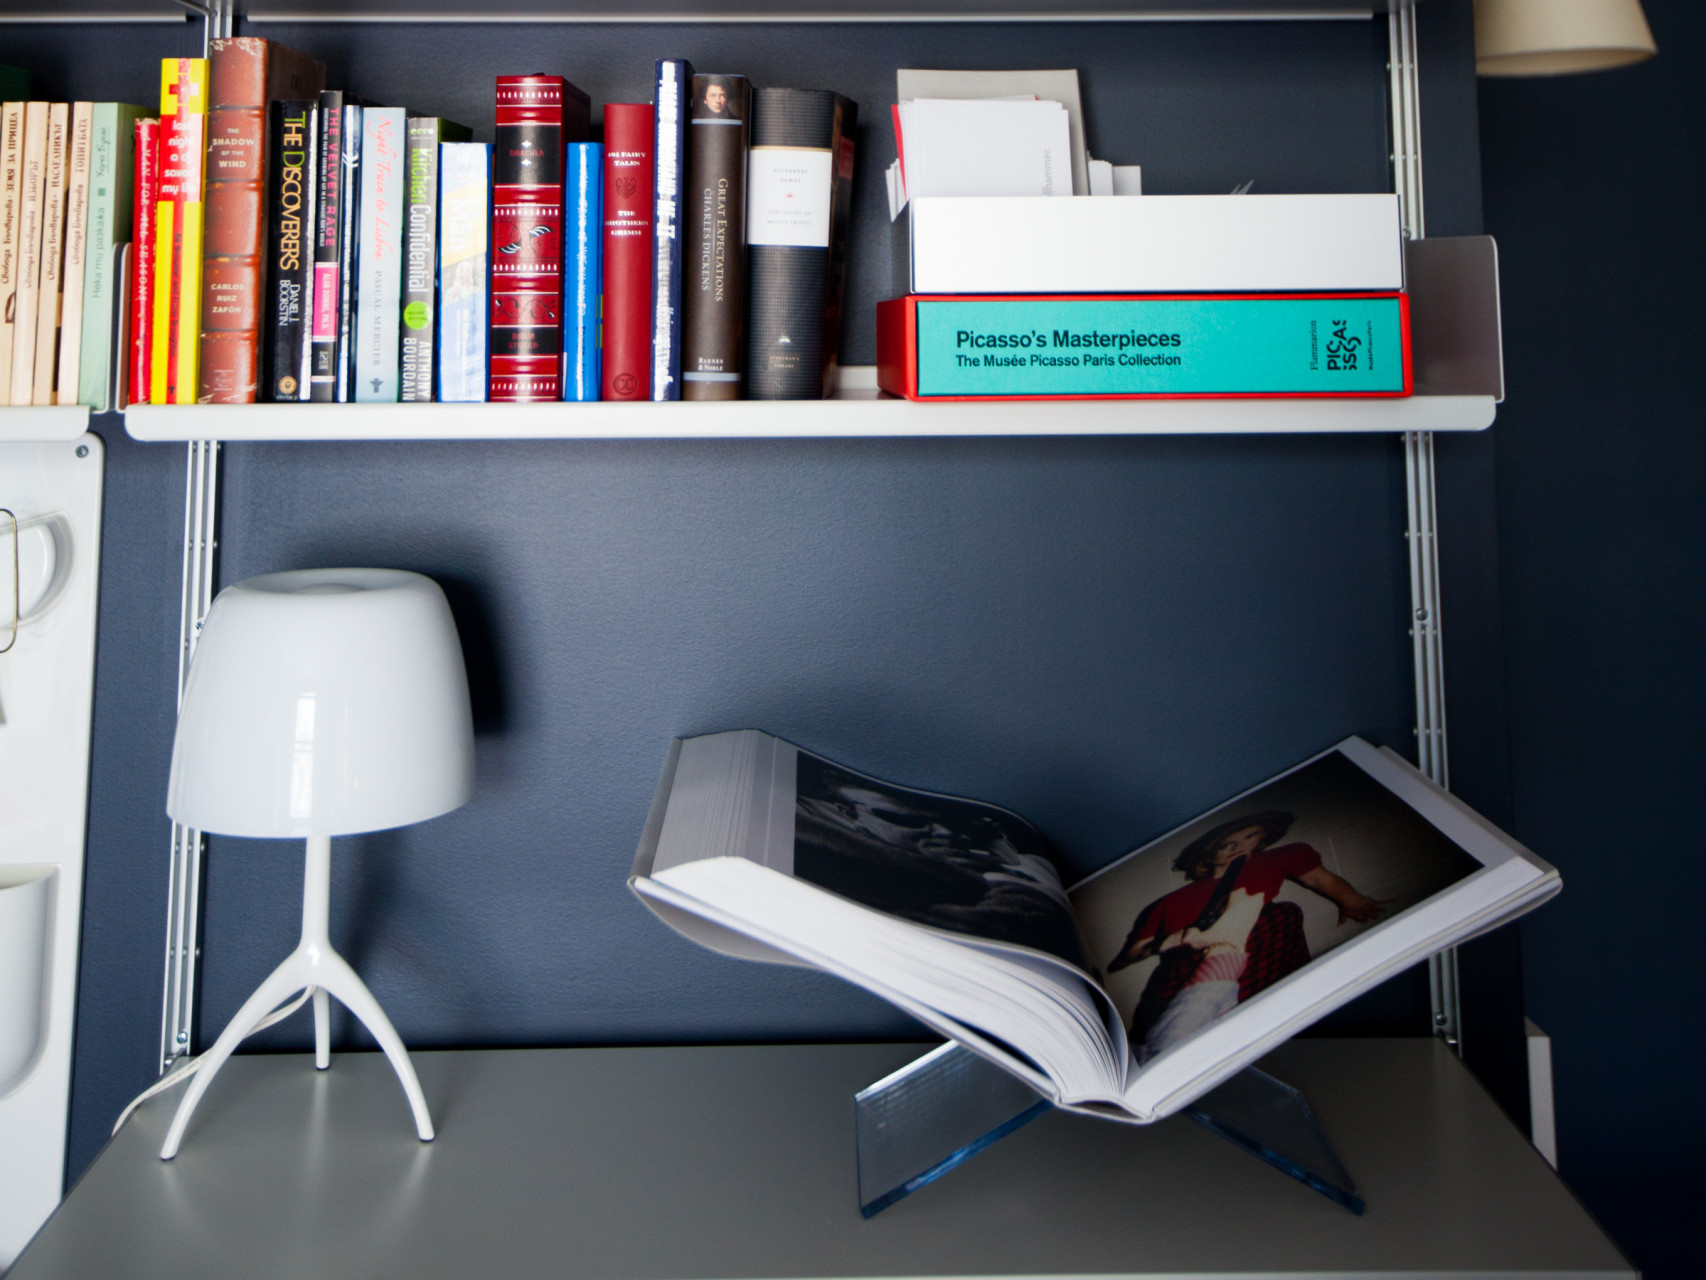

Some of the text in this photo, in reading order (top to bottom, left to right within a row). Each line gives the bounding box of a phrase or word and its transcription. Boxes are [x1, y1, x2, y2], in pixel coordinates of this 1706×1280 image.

[280, 111, 306, 270] THE DISCOVERERS
[326, 108, 339, 247] THE VELVET RAGE
[95, 208, 106, 250] разкажа
[366, 117, 397, 366] Night Train to Lisbon PASCAL MERCIER
[408, 148, 433, 292] Kitchen Confidential
[701, 188, 713, 291] CHARLES DICKENS
[715, 178, 729, 302] GREAT EXPECTATIONS
[92, 274, 103, 298] Нека
[279, 280, 291, 326] BOORSTIN
[288, 284, 300, 314] DANIEL
[402, 337, 418, 400] BOURDAIN
[417, 341, 431, 397] ANTHONY
[956, 354, 1181, 367] The Musée Picasso Paris Collection
[957, 330, 1181, 352] Picasso's Masterpieces
[1310, 320, 1319, 371] Flammarion
